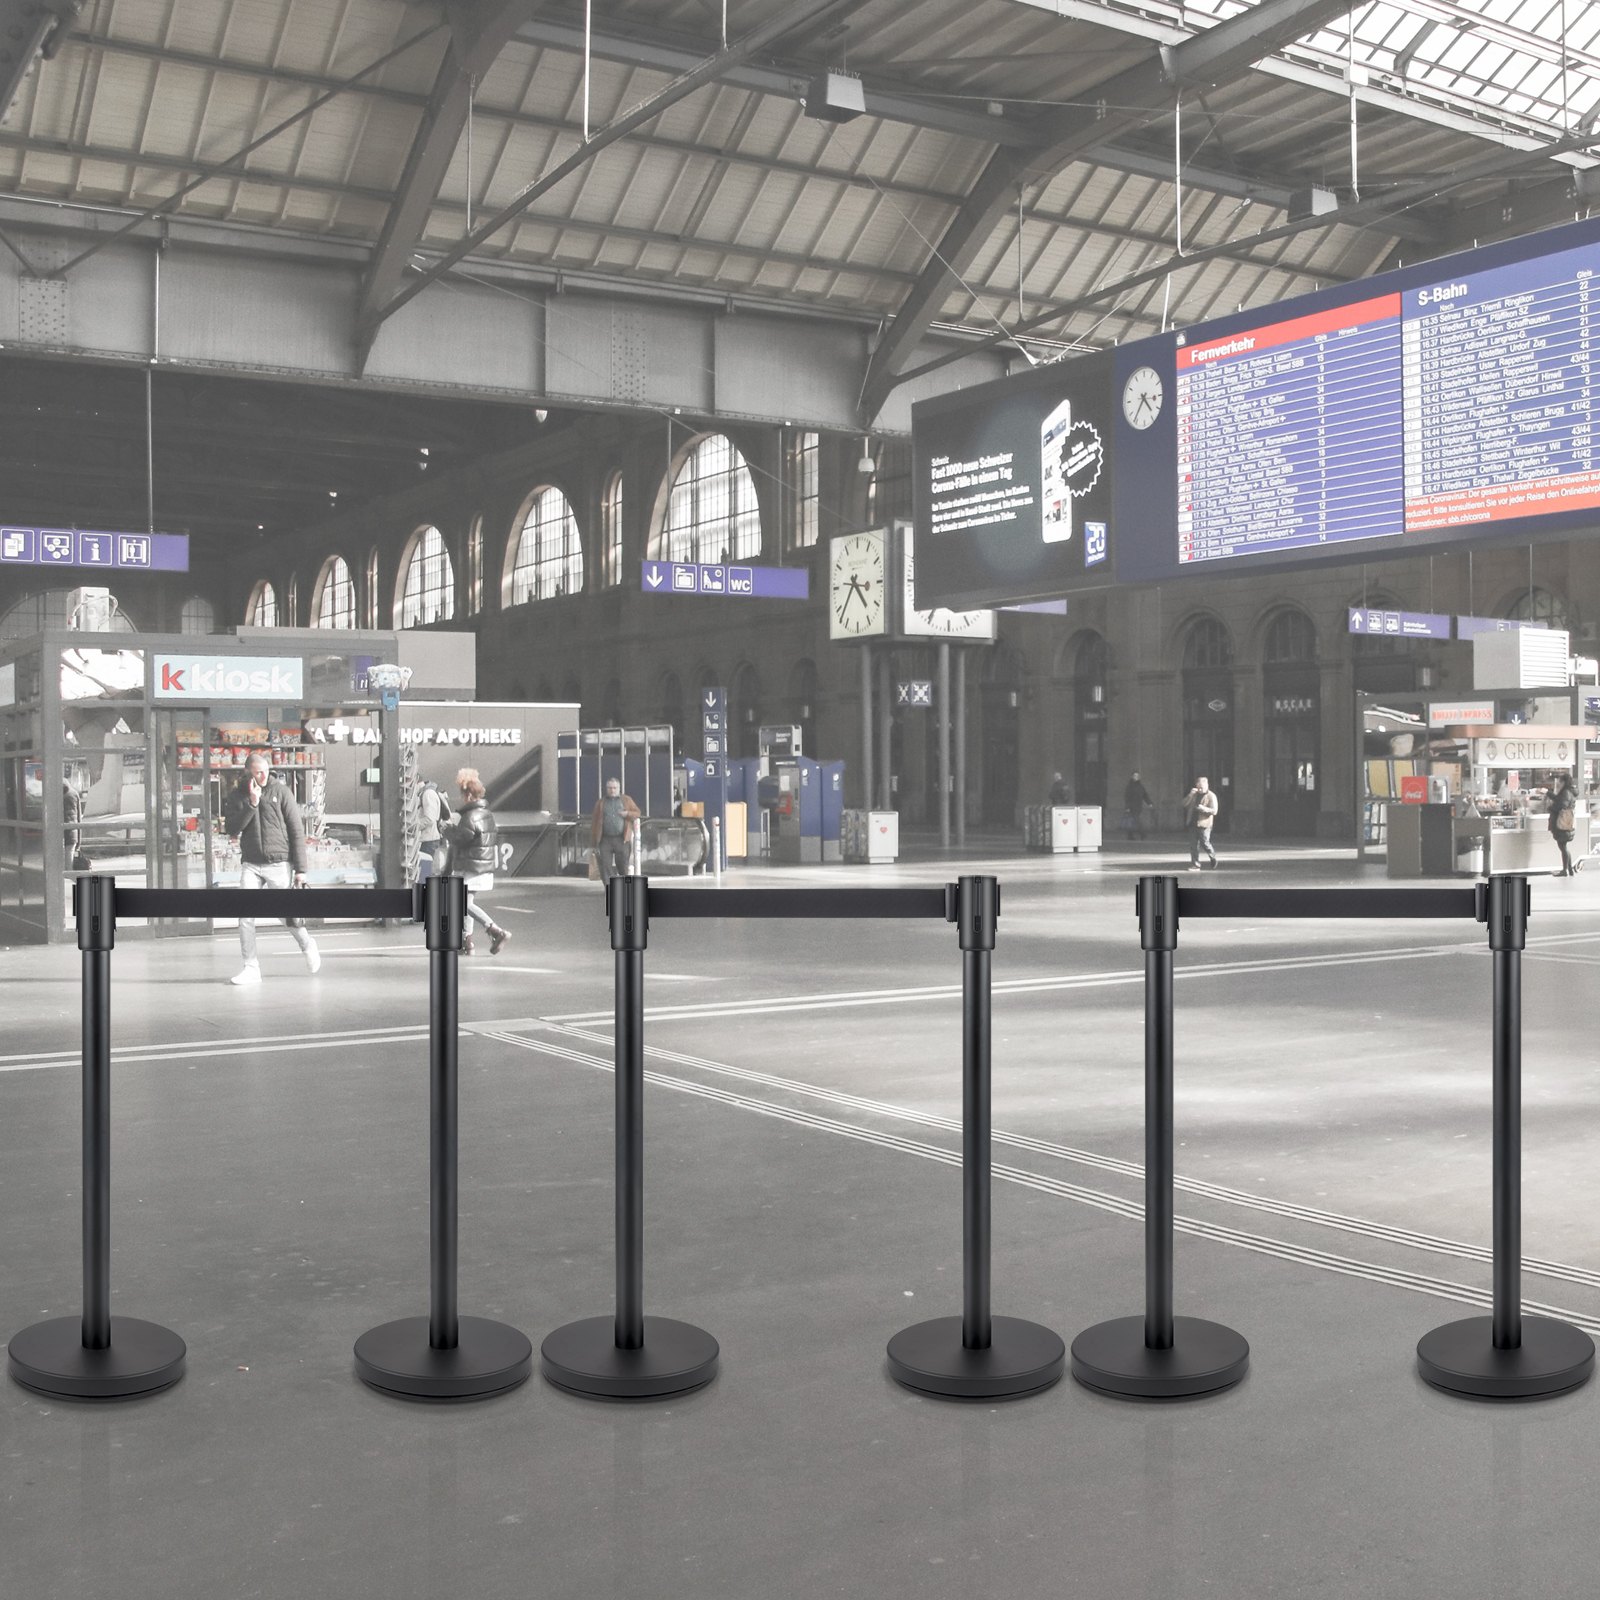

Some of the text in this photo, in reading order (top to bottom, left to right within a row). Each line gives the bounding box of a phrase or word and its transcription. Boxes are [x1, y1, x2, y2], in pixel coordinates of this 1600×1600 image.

[1577, 270, 1592, 279] Gleis
[1579, 281, 1588, 290] 22
[1419, 284, 1467, 305] S-Bahn
[1580, 293, 1589, 302] 32
[1580, 305, 1588, 313] 41
[1580, 317, 1588, 326] 21
[1580, 329, 1589, 337] 42
[1580, 341, 1589, 349] 44
[1192, 338, 1254, 362] Fernverkehr
[1581, 365, 1590, 373] 33
[1585, 377, 1590, 385] 5
[1581, 389, 1590, 397] 34
[1586, 413, 1591, 421] 3
[932, 467, 946, 479] Fast
[979, 453, 1013, 468] Schweizer
[1582, 461, 1591, 470] 32
[999, 467, 1012, 480] Tag
[730, 579, 751, 591] WC
[162, 663, 294, 693] k kiosk
[435, 728, 522, 744] APOTHEKE
[1504, 742, 1551, 760] GRILL
